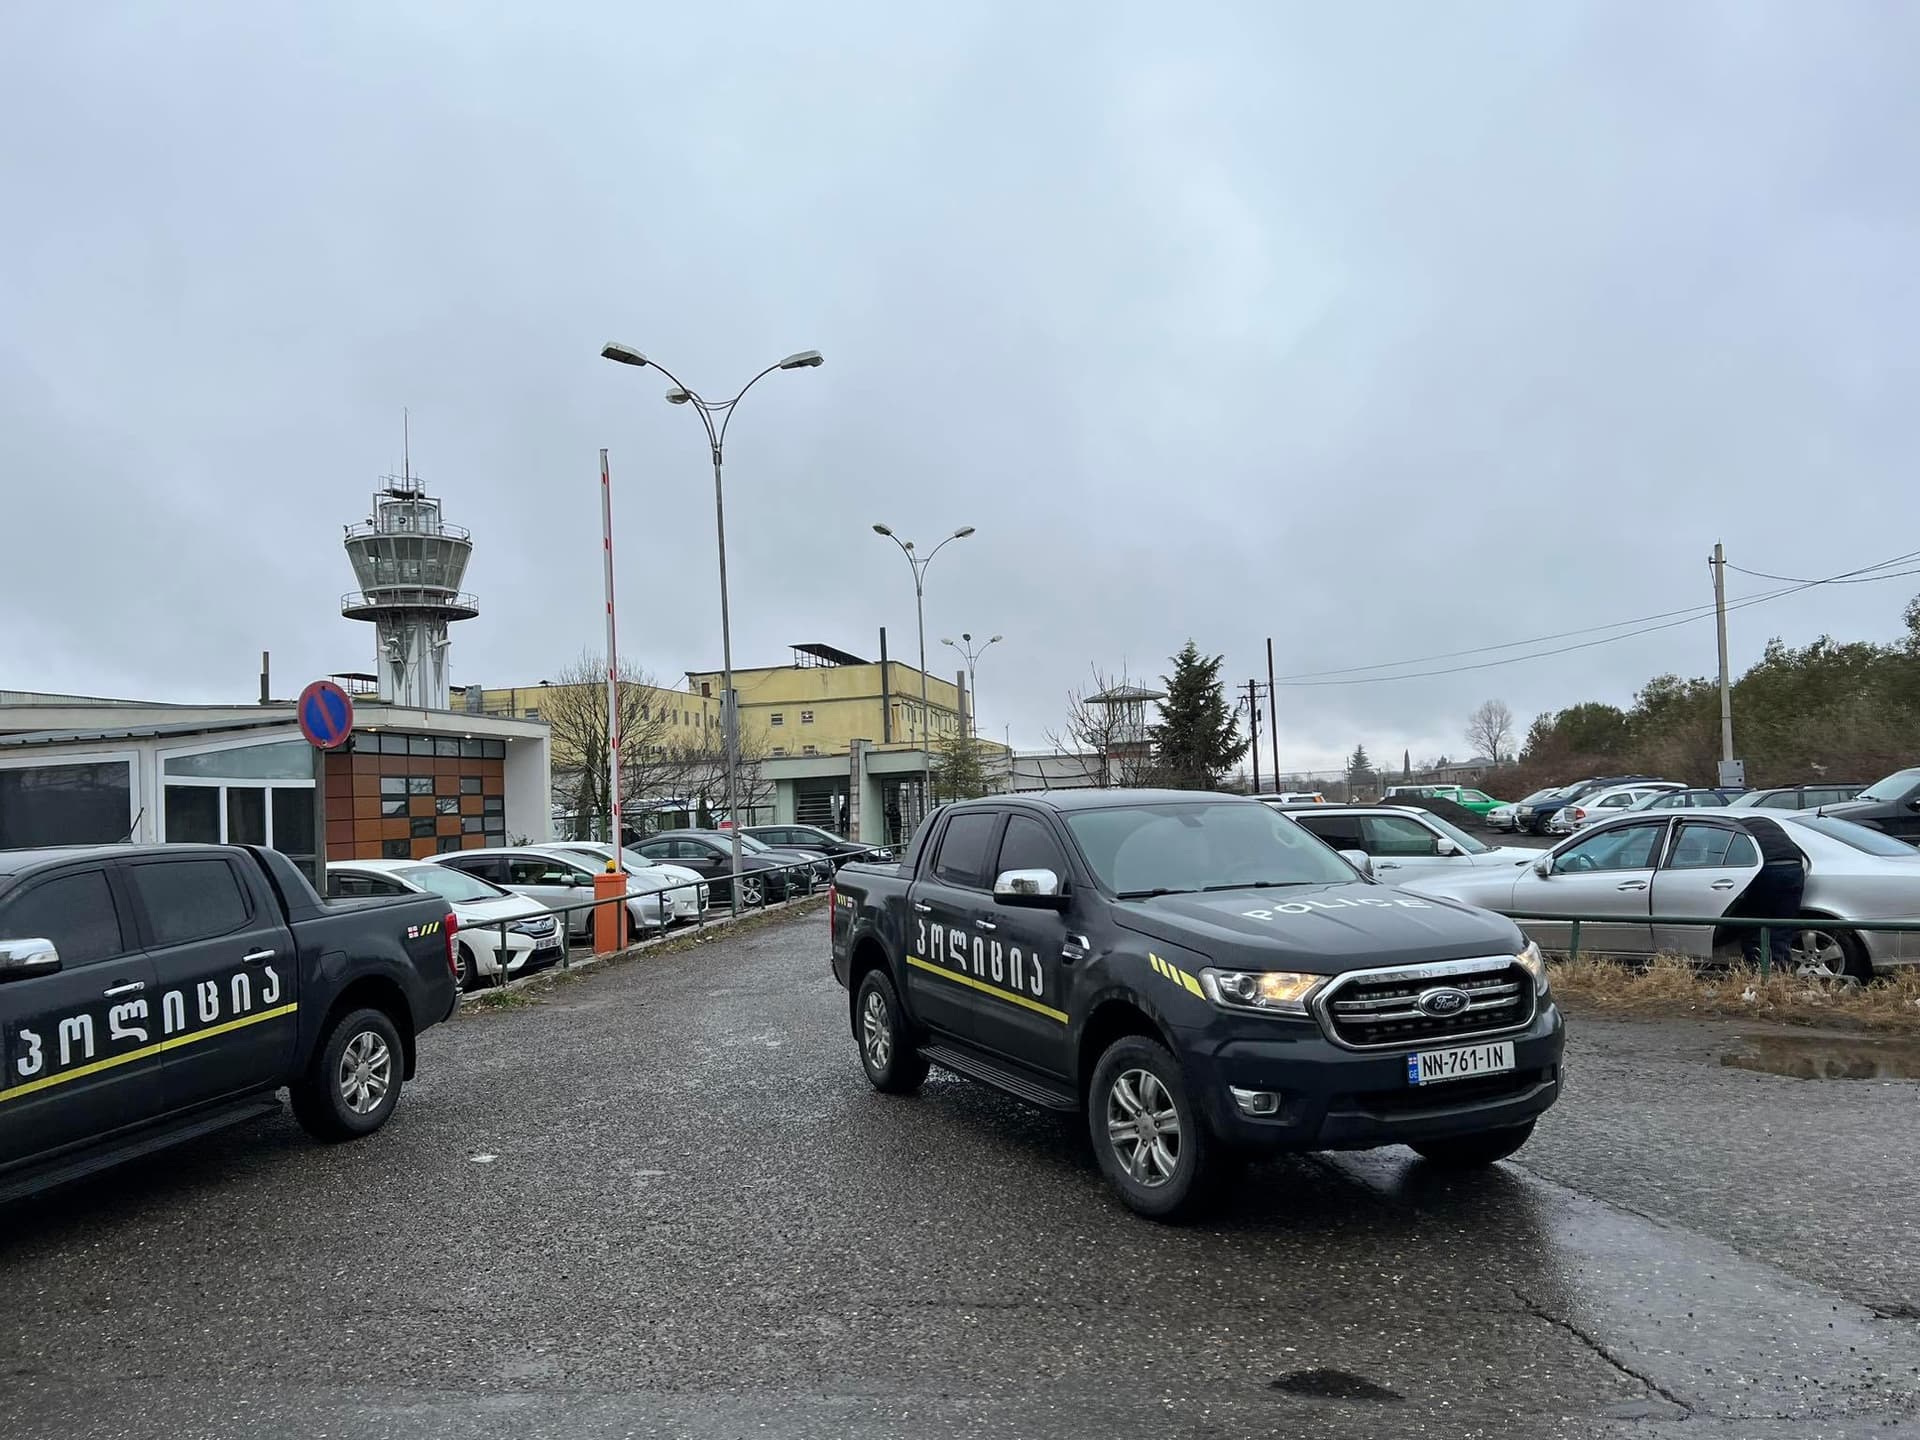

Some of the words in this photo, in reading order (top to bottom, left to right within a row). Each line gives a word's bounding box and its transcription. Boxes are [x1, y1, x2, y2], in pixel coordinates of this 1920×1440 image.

[1241, 898, 1432, 921] POLICE
[916, 918, 1043, 996] პოლიცია
[1433, 994, 1461, 1011] Ford
[17, 965, 281, 1076] პოლიცია
[1422, 1045, 1504, 1077] NN-761-IN
